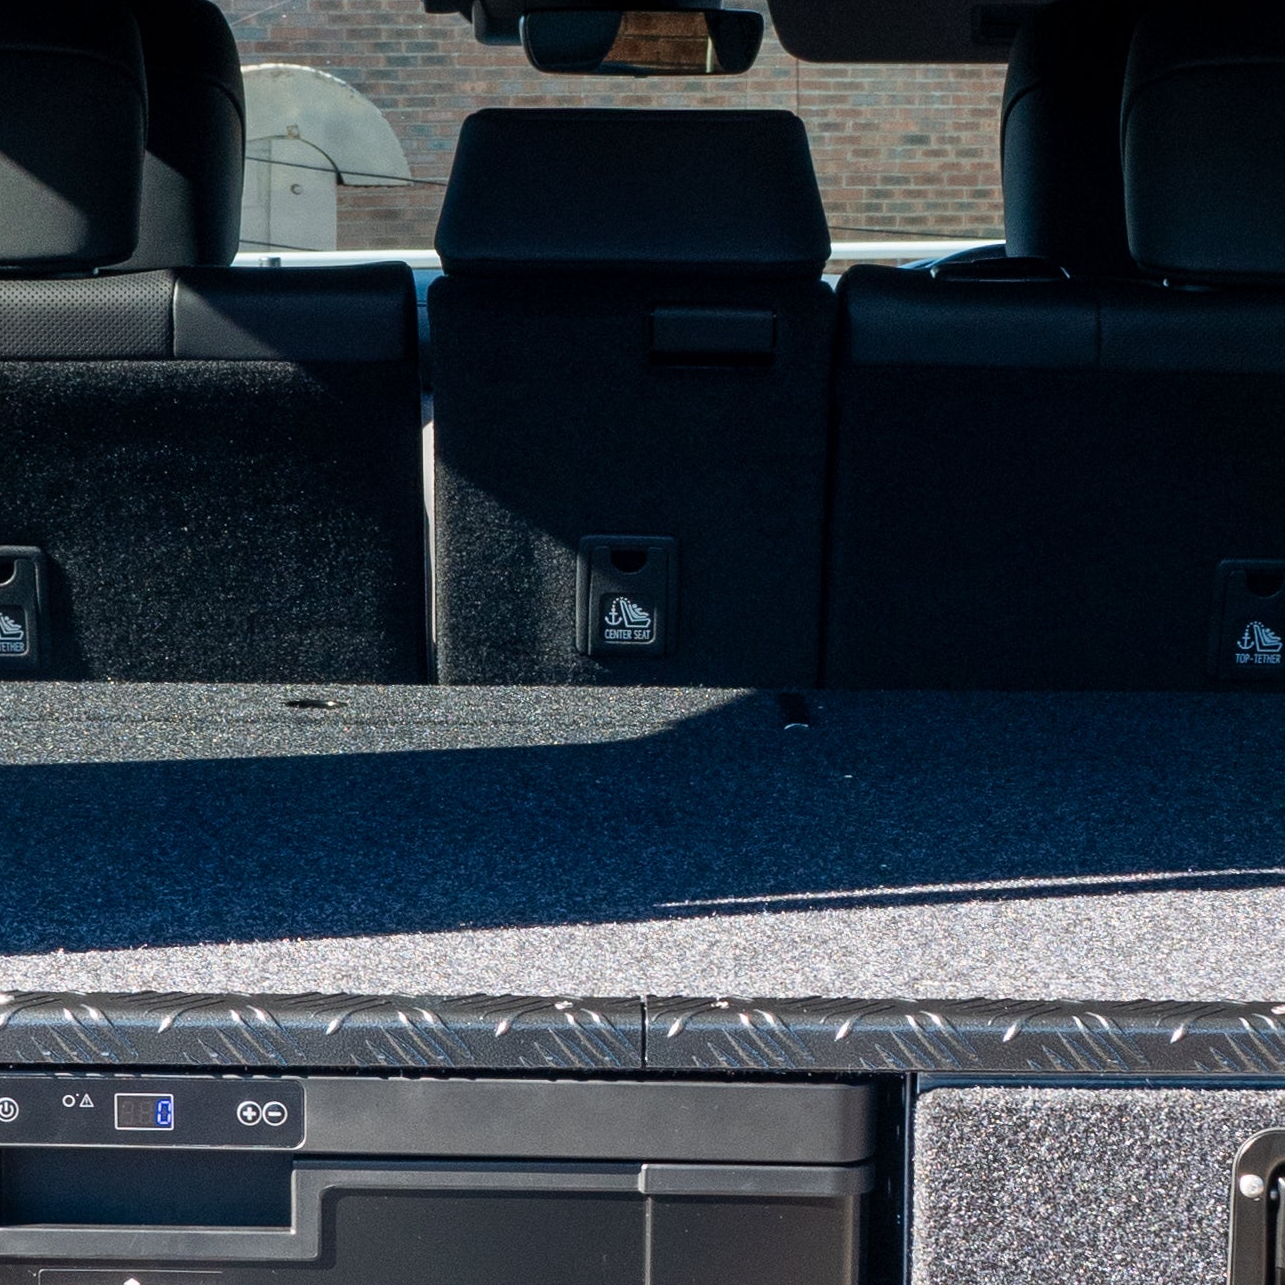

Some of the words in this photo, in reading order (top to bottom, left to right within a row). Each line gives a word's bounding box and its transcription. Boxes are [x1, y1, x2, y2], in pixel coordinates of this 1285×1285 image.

[604, 629, 632, 640] CENTER
[633, 629, 651, 640] SEAT
[1235, 653, 1282, 664] TOP-TETHER
